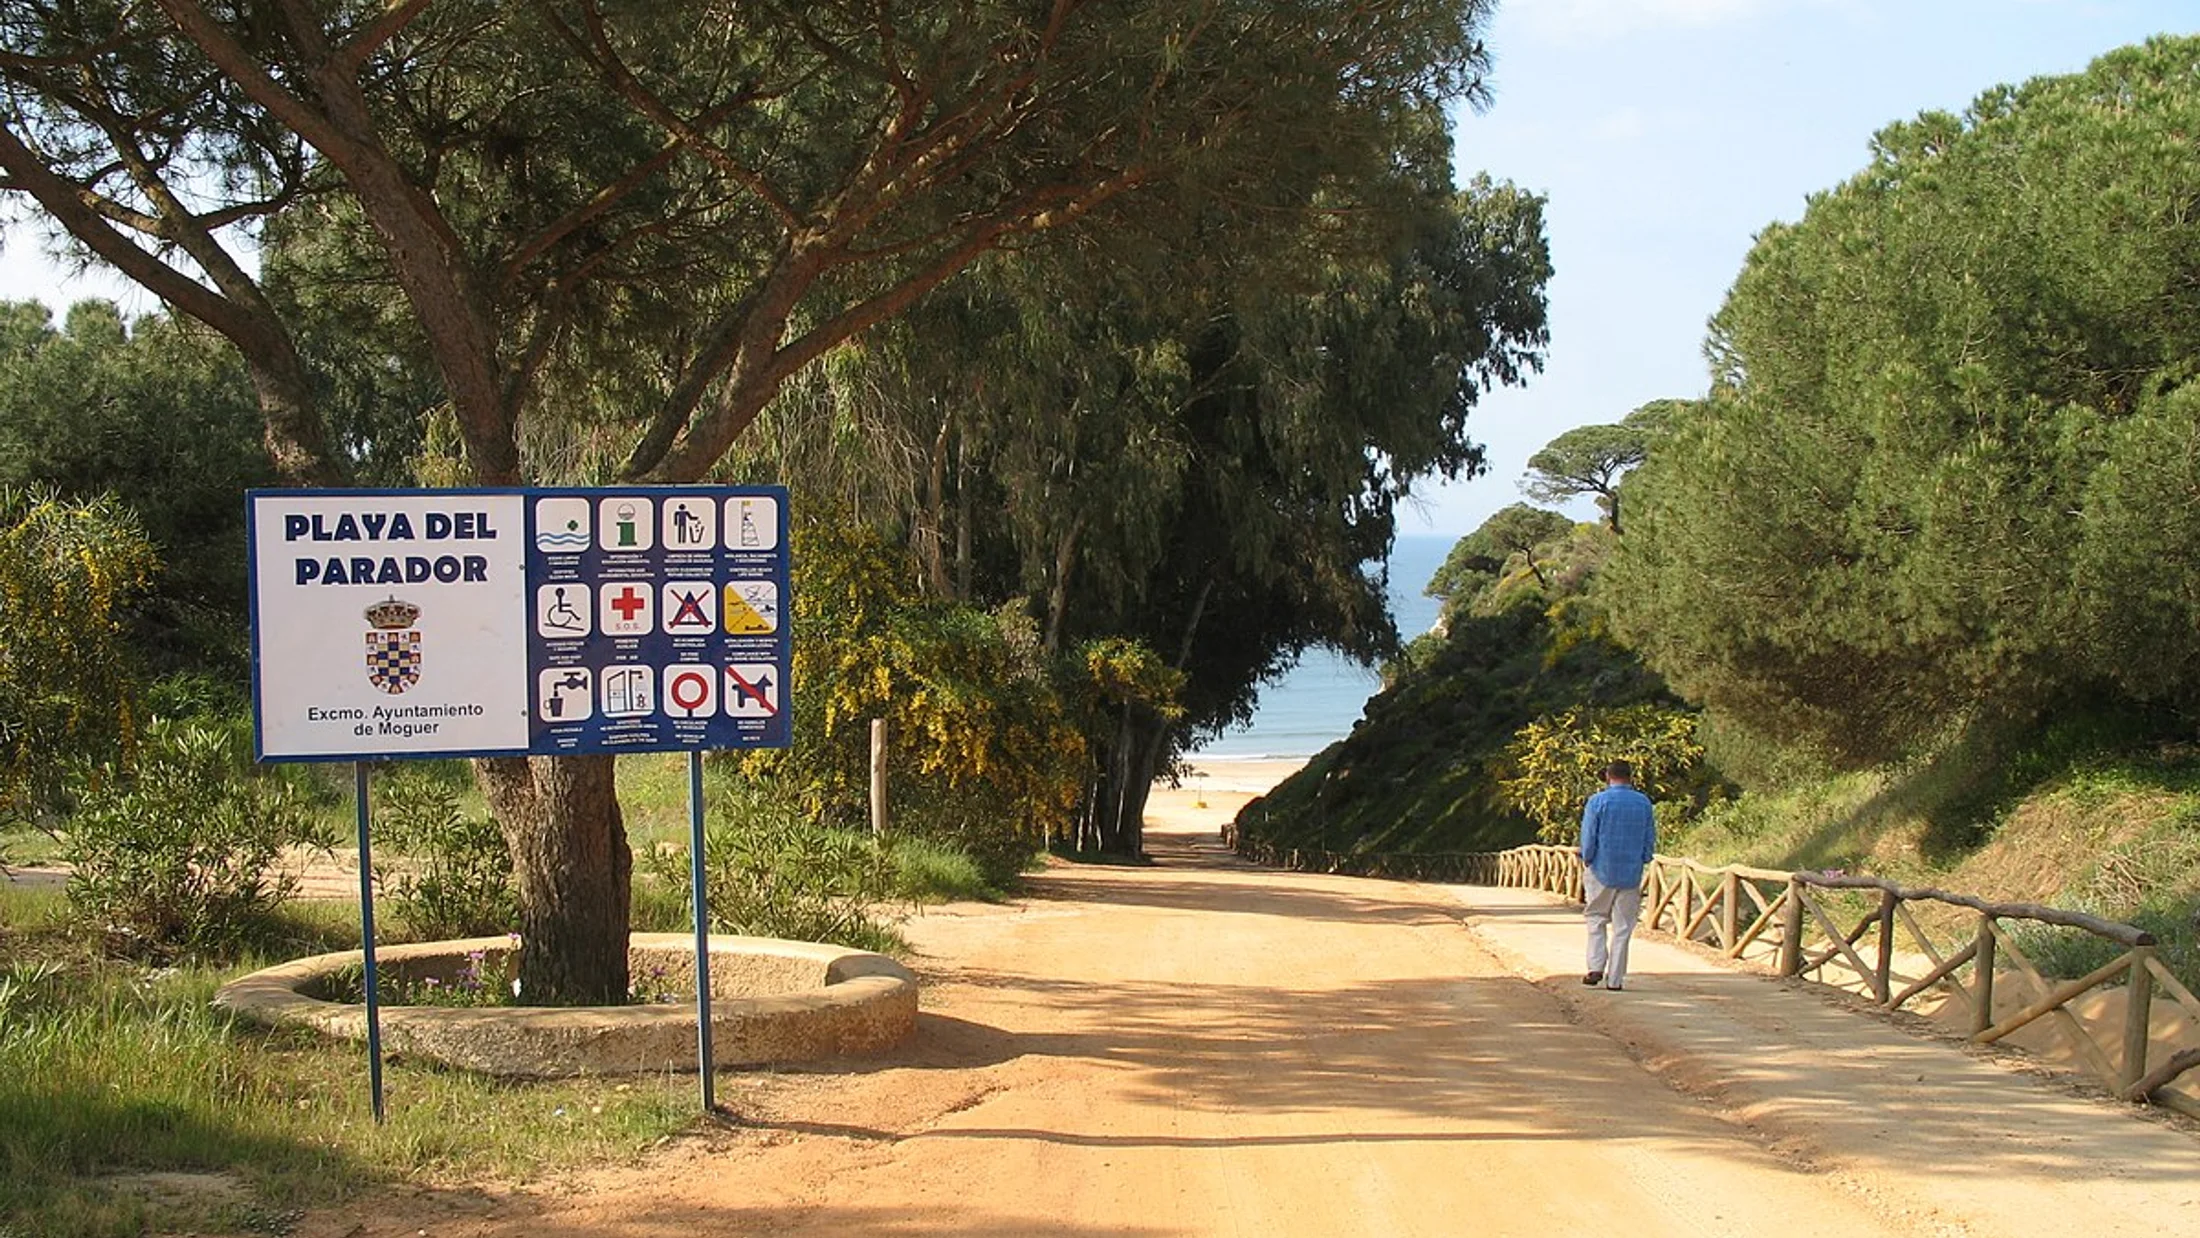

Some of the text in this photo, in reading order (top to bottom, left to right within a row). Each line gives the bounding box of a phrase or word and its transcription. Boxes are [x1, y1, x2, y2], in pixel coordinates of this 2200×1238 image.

[284, 512, 497, 541] PLAYA DEL
[295, 555, 488, 585] PARADOR
[307, 703, 484, 720] Excmo. Ayuntamiento
[353, 721, 440, 738] de Moguer
